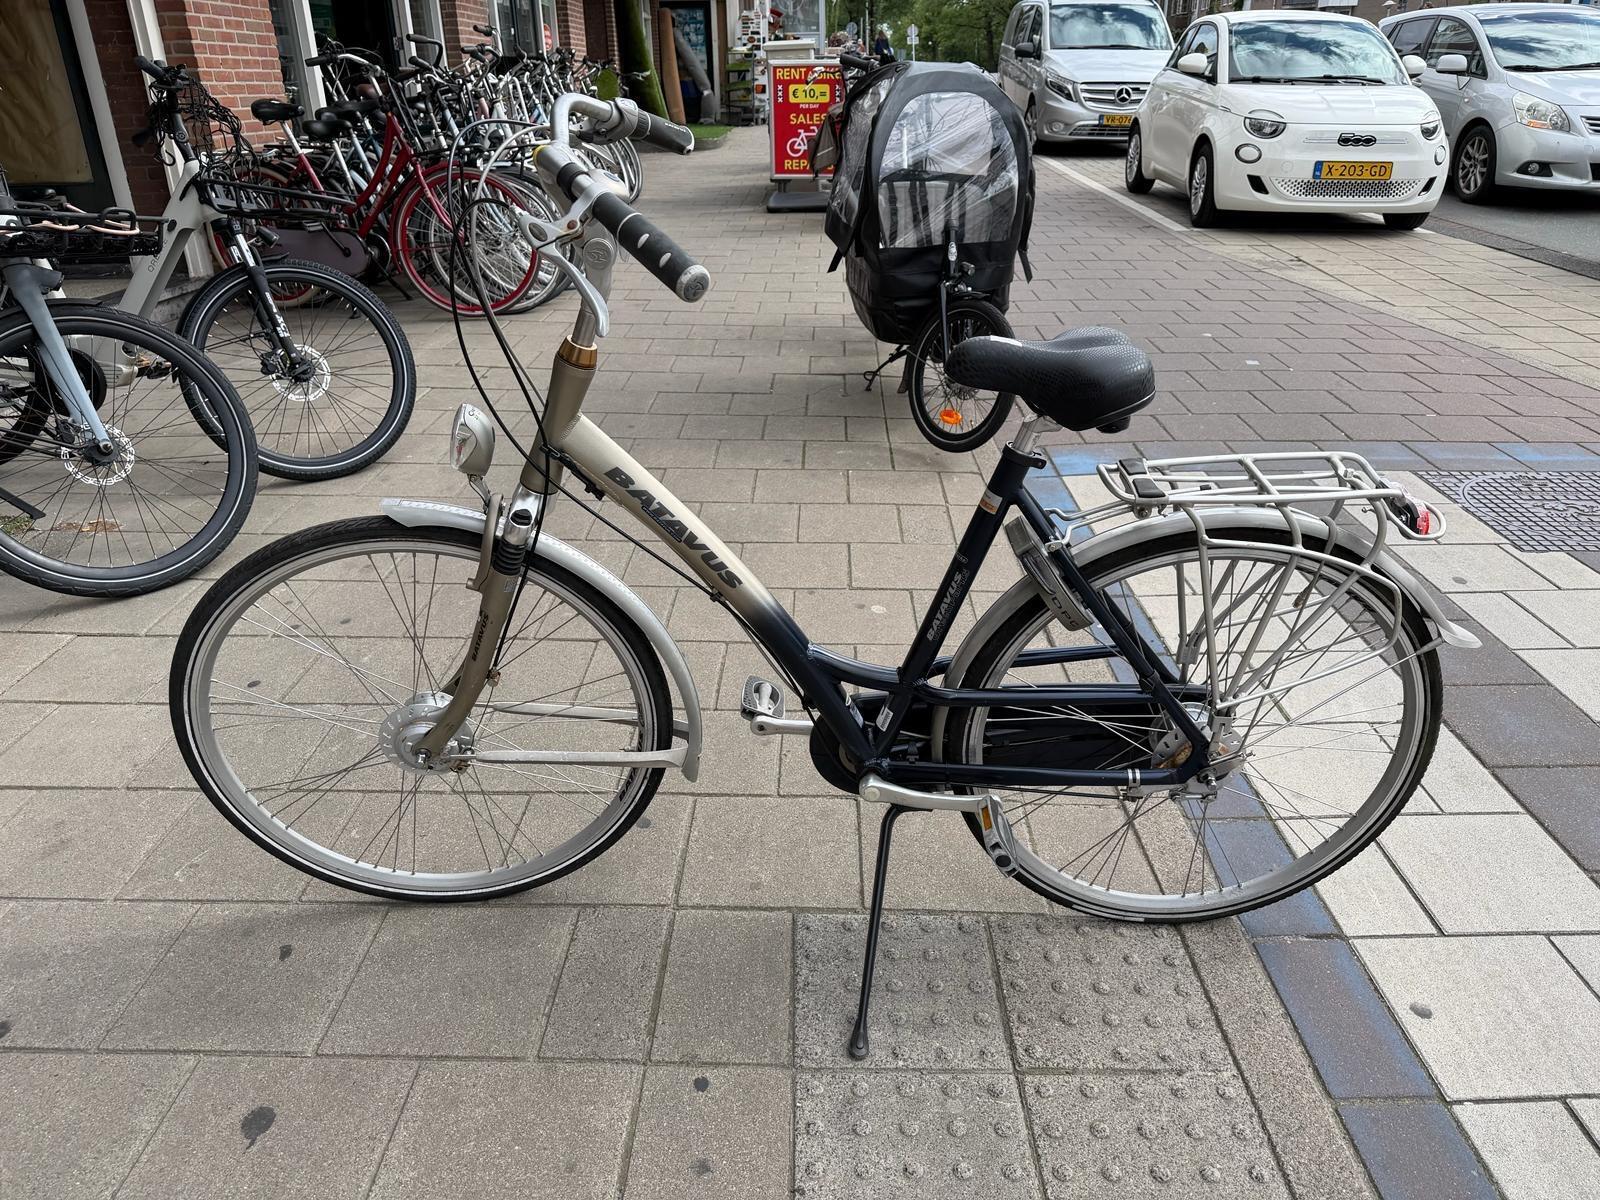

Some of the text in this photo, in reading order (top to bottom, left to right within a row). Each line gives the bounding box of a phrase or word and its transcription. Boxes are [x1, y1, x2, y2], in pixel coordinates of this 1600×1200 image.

[776, 68, 806, 80] RENT
[792, 88, 799, 98] €
[1337, 132, 1377, 147] 500
[1325, 164, 1388, 177] X-203-GD
[604, 467, 743, 589] BATAVUS
[926, 571, 962, 641] BATAVUS
[471, 613, 489, 662] BATAVUS
